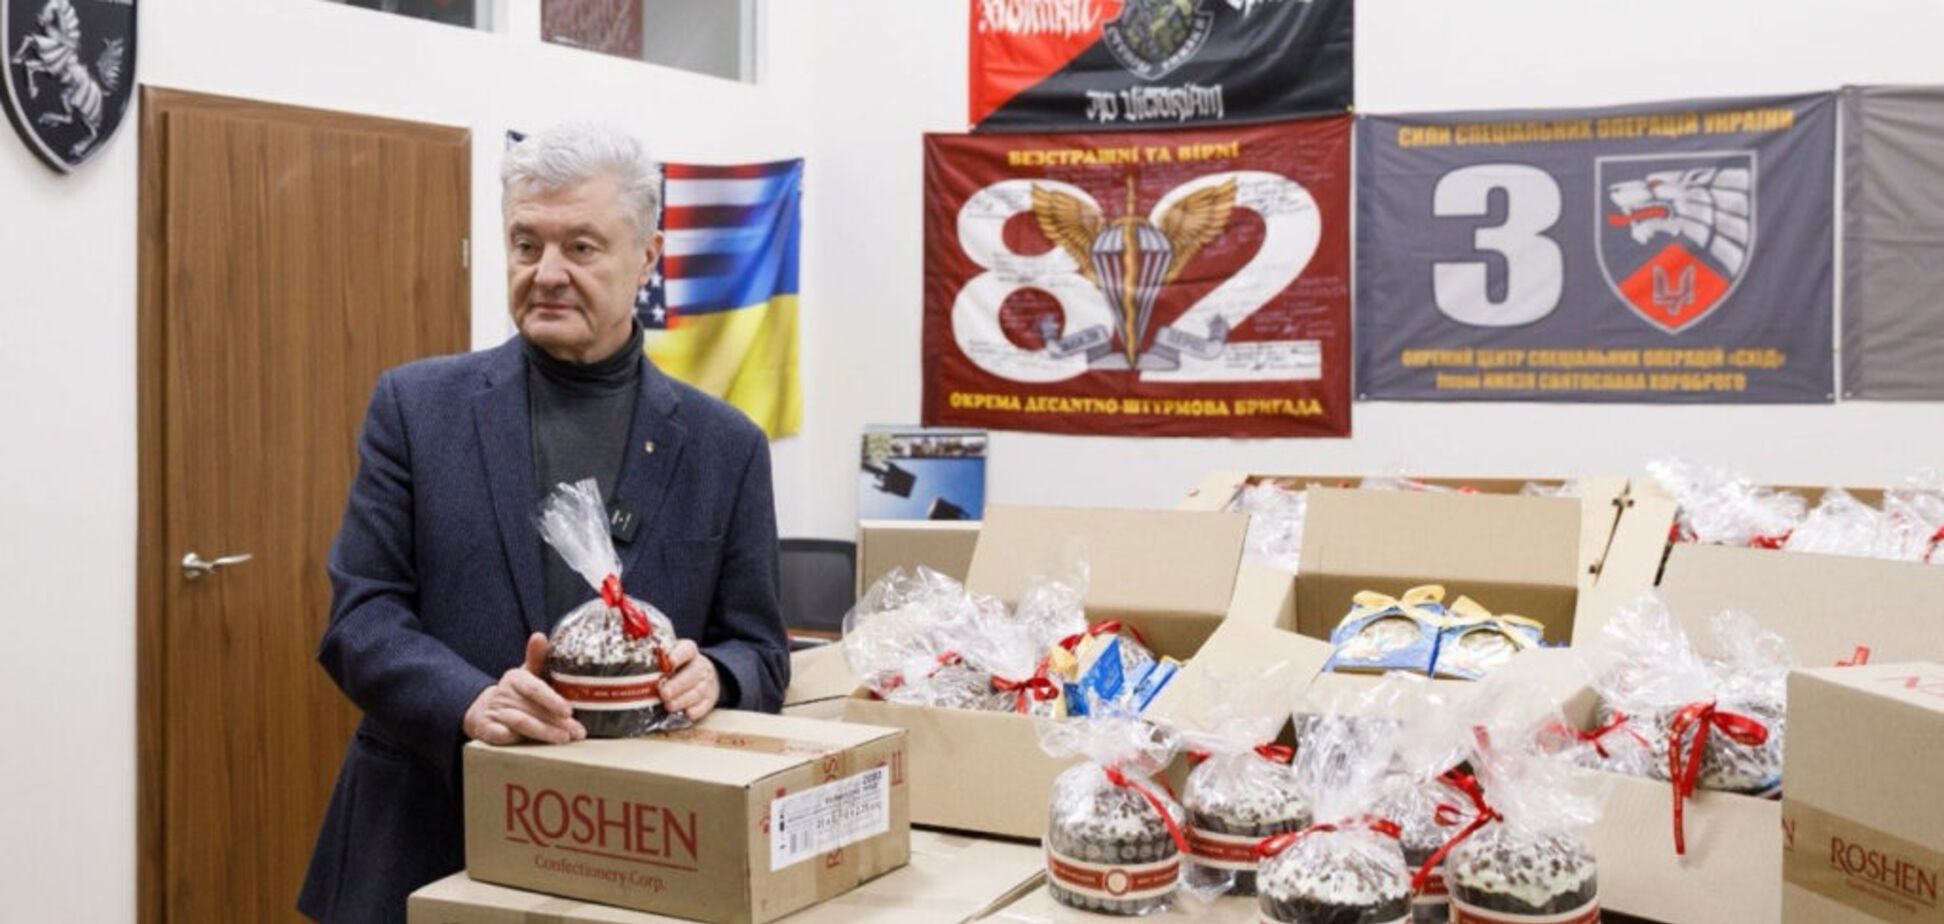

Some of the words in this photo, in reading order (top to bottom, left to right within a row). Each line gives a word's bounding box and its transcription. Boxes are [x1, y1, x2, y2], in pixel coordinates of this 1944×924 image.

[1008, 146, 1139, 166] БЕЗСТРАШНІ
[1145, 145, 1172, 163] ТА
[1178, 140, 1240, 162] ВІРНІ
[1398, 125, 1450, 147] СИЛИ
[1455, 119, 1592, 146] СПЕЦІАЛЬНИХ
[1596, 110, 1699, 140] ОПЕРАЦІЙ
[1703, 107, 1795, 135] УКРАЇНИ
[1433, 163, 1563, 327] 3
[951, 170, 1322, 382] 82
[949, 392, 1021, 411] ОКРЕМА
[1024, 395, 1230, 416] ДЕСАНТНО-ШТУРМОВА
[1233, 398, 1324, 417] БРИГАДА
[505, 783, 698, 862] ROSHEN
[534, 854, 627, 886] Confectionery
[629, 870, 666, 892] Corp.
[1830, 836, 1937, 900] ROSHEN
